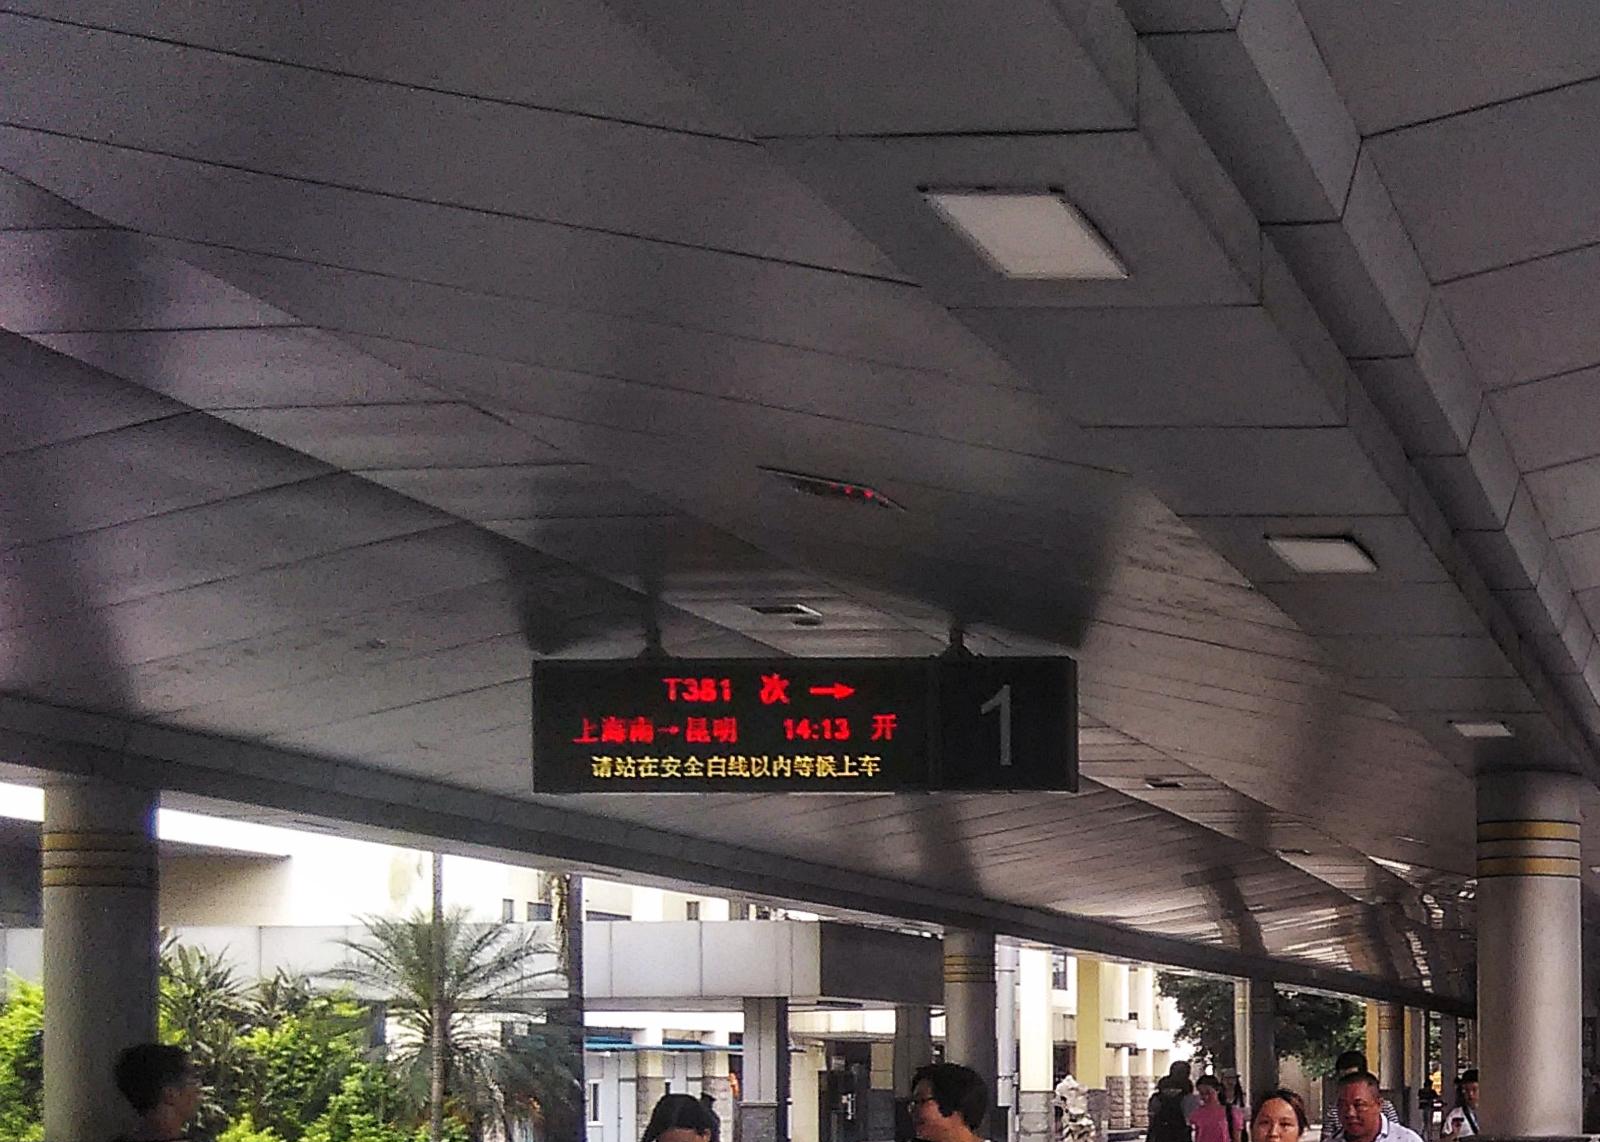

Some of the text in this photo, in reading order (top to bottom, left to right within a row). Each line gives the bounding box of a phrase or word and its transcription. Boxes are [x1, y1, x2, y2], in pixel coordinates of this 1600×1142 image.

[759, 673, 790, 704] 次
[686, 716, 738, 743] 昆明
[784, 718, 850, 741] 14:13
[871, 713, 897, 741] 开
[981, 684, 1012, 766] 1
[591, 755, 881, 777] 请站在安全白线以内等候上车
